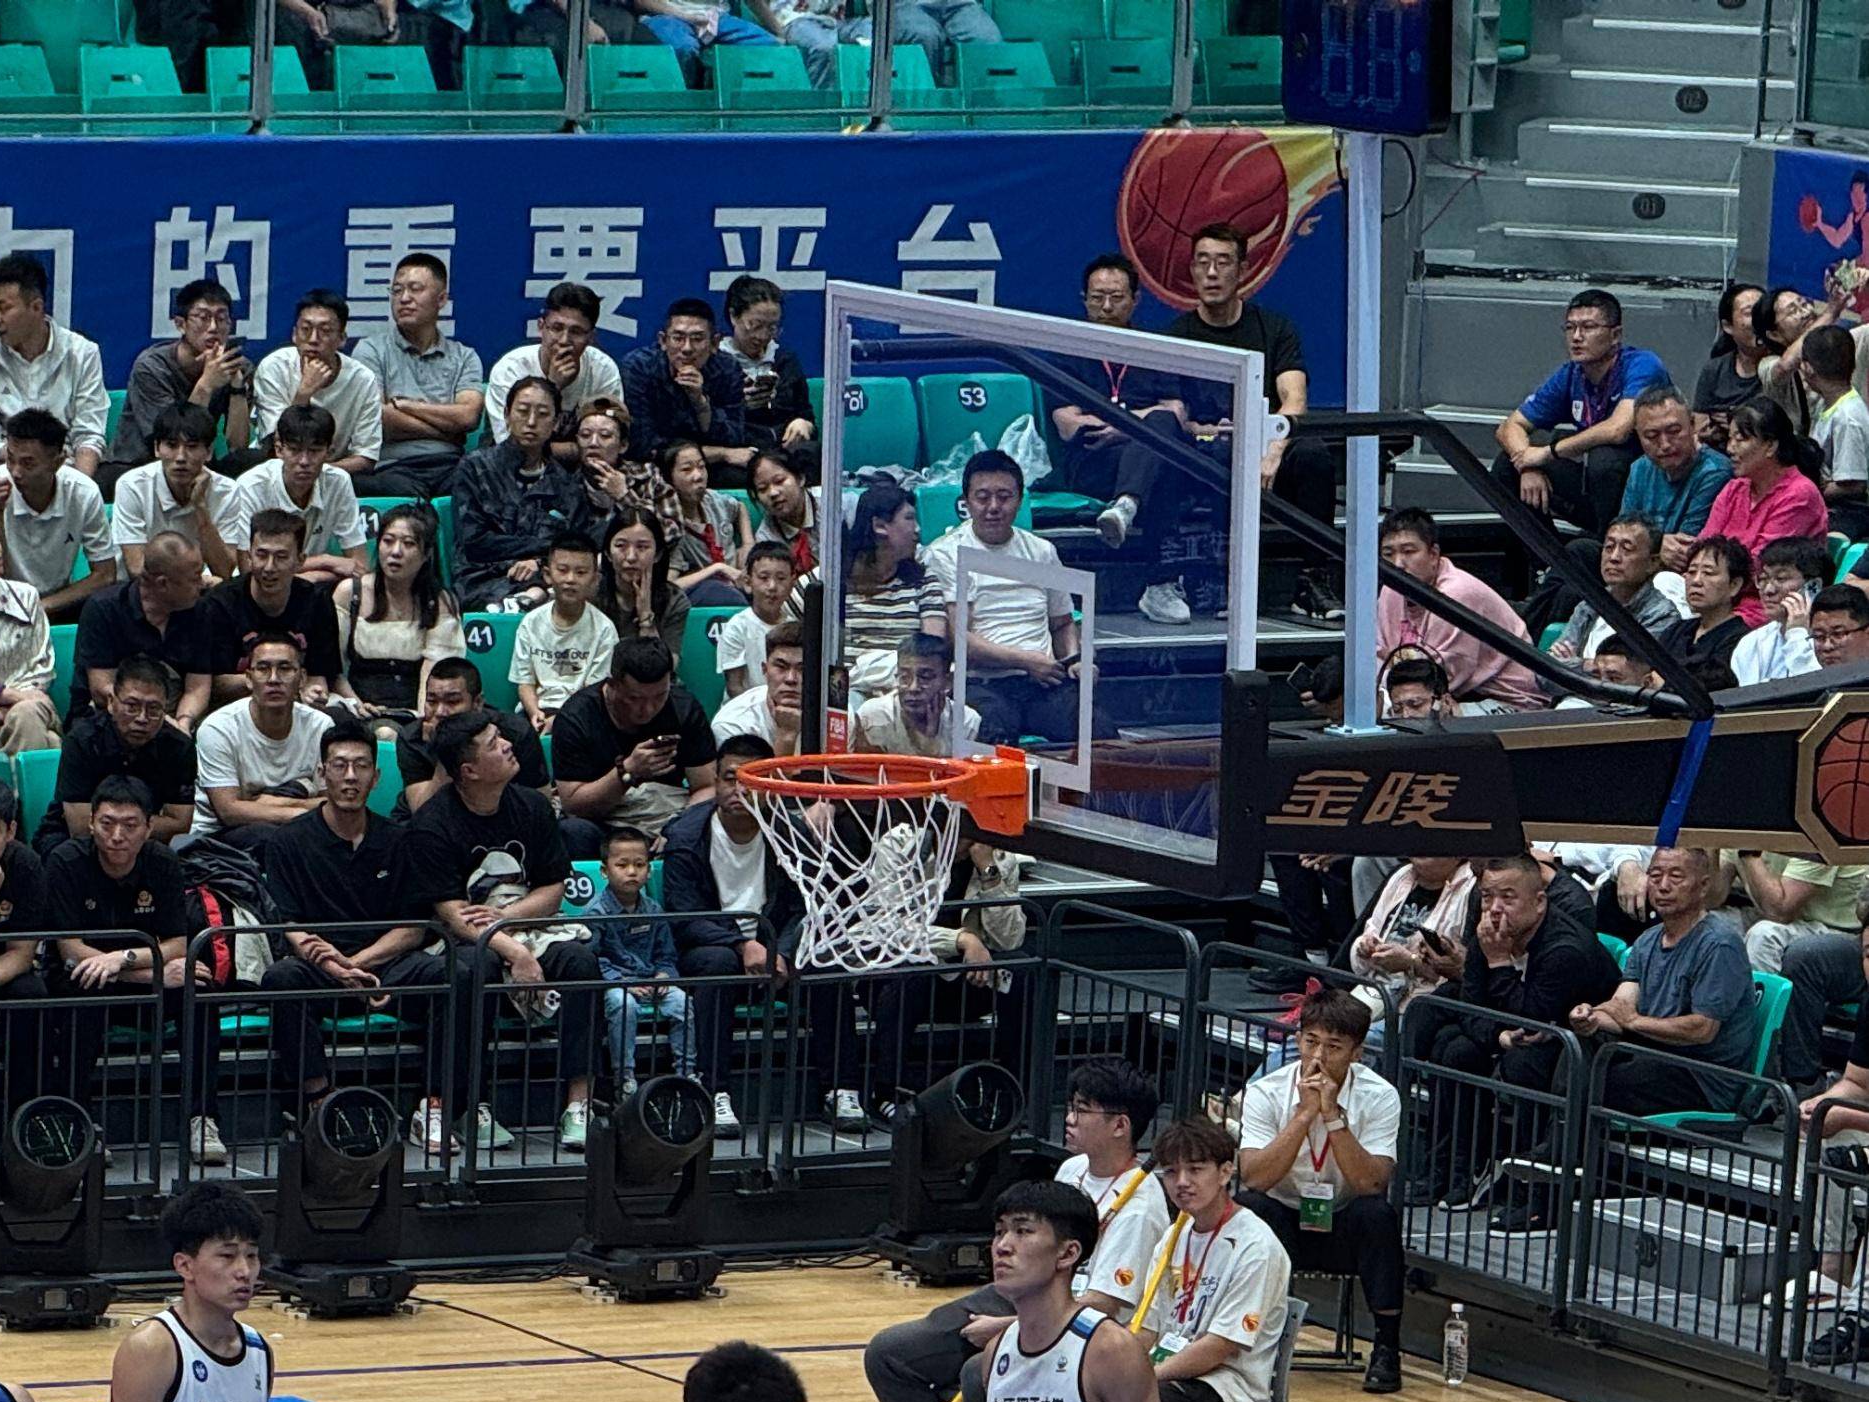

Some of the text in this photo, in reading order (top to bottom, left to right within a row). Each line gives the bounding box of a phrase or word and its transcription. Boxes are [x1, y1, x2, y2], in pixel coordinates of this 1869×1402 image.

[959, 387, 987, 407] 53
[957, 502, 971, 519] 5
[467, 626, 494, 647] 41
[1265, 770, 1493, 831] 金陵
[564, 876, 593, 899] 39
